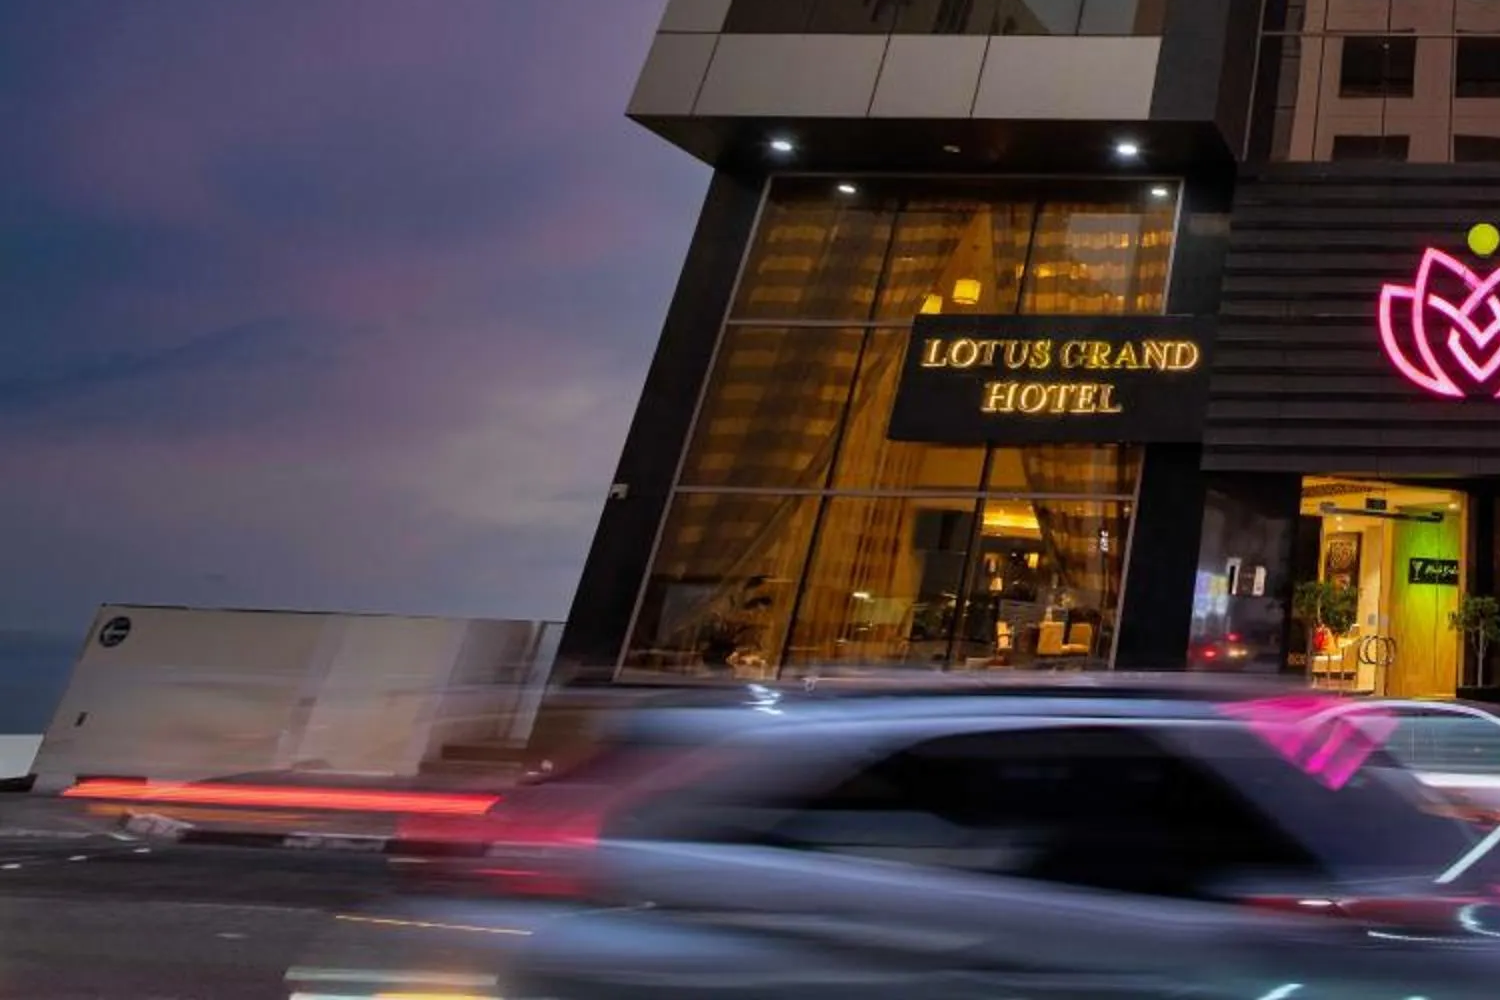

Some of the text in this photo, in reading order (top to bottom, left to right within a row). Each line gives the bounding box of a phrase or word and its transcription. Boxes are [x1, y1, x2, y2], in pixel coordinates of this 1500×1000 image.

[921, 338, 1200, 371] LOTUS GRAND
[980, 382, 1124, 414] HOTEL
